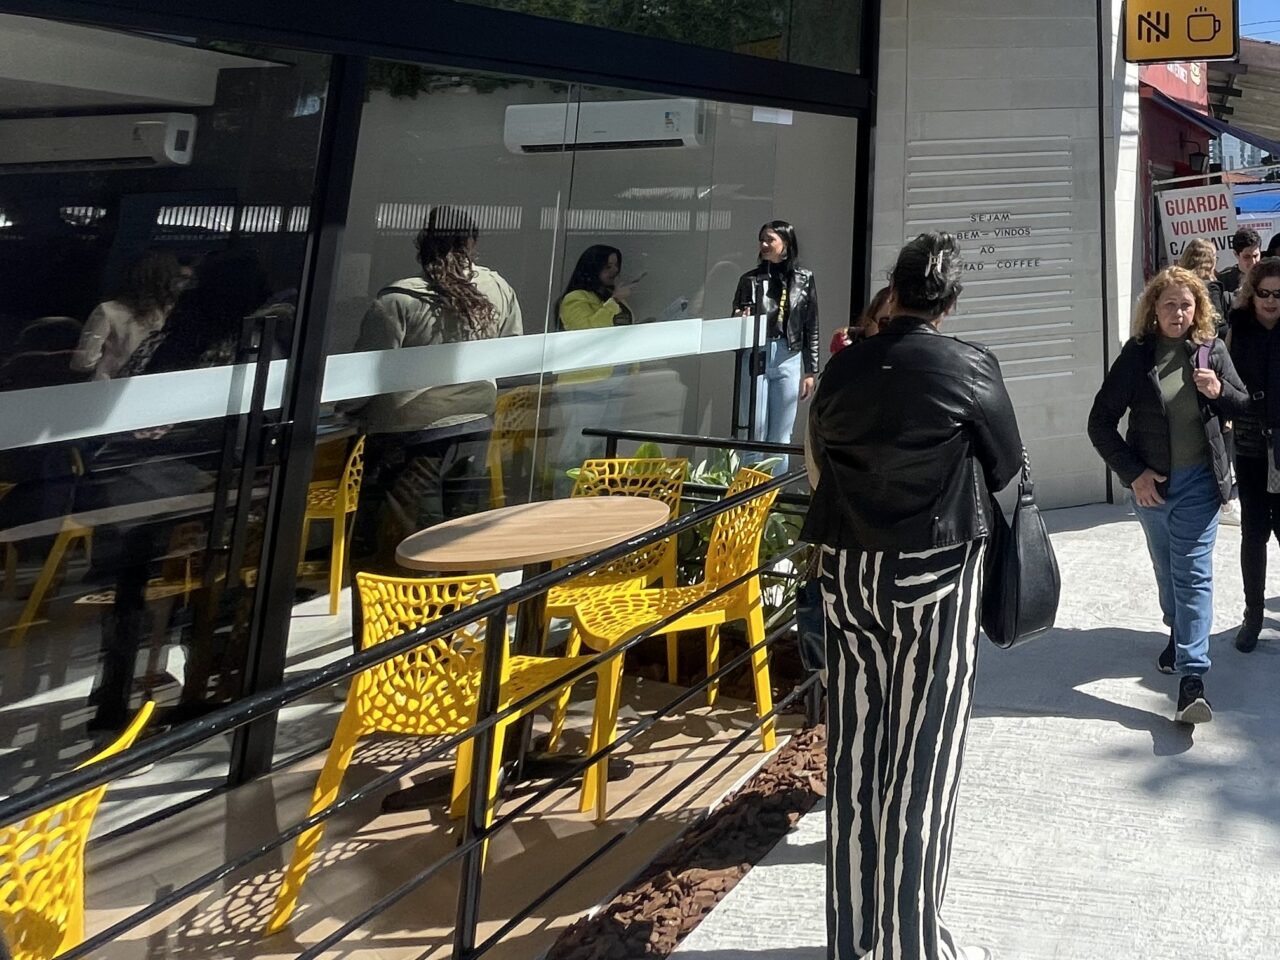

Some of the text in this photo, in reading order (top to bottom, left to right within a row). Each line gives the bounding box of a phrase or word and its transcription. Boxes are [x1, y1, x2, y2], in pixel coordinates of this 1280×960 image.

[1165, 193, 1229, 217] GUARDA
[970, 213, 1010, 222] SEJAM
[1171, 216, 1229, 236] VOLUME
[980, 246, 995, 254] AO
[997, 258, 1041, 269] COFFEE
